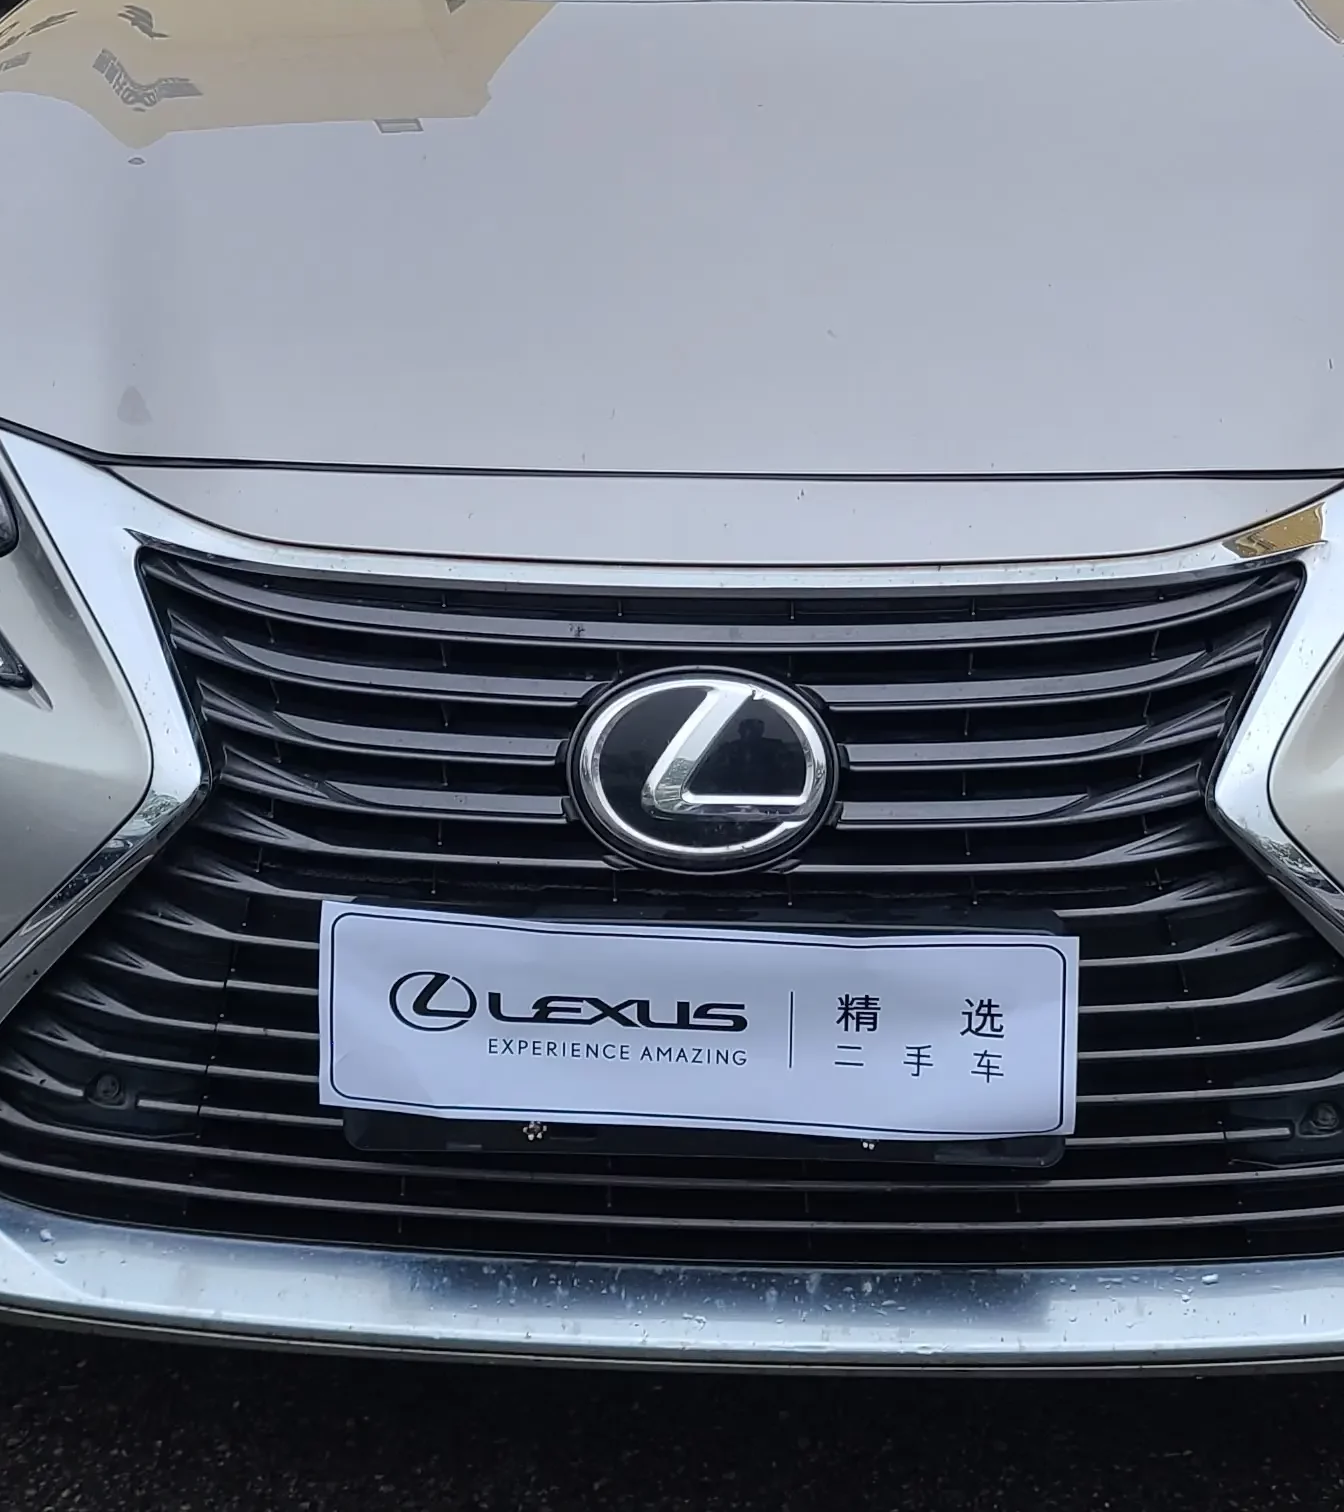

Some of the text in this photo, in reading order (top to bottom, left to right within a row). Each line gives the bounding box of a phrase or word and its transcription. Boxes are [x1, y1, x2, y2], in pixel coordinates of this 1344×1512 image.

[487, 991, 748, 1032] LEXUS
[487, 1037, 748, 1067] EXPERIENCE AMAZING
